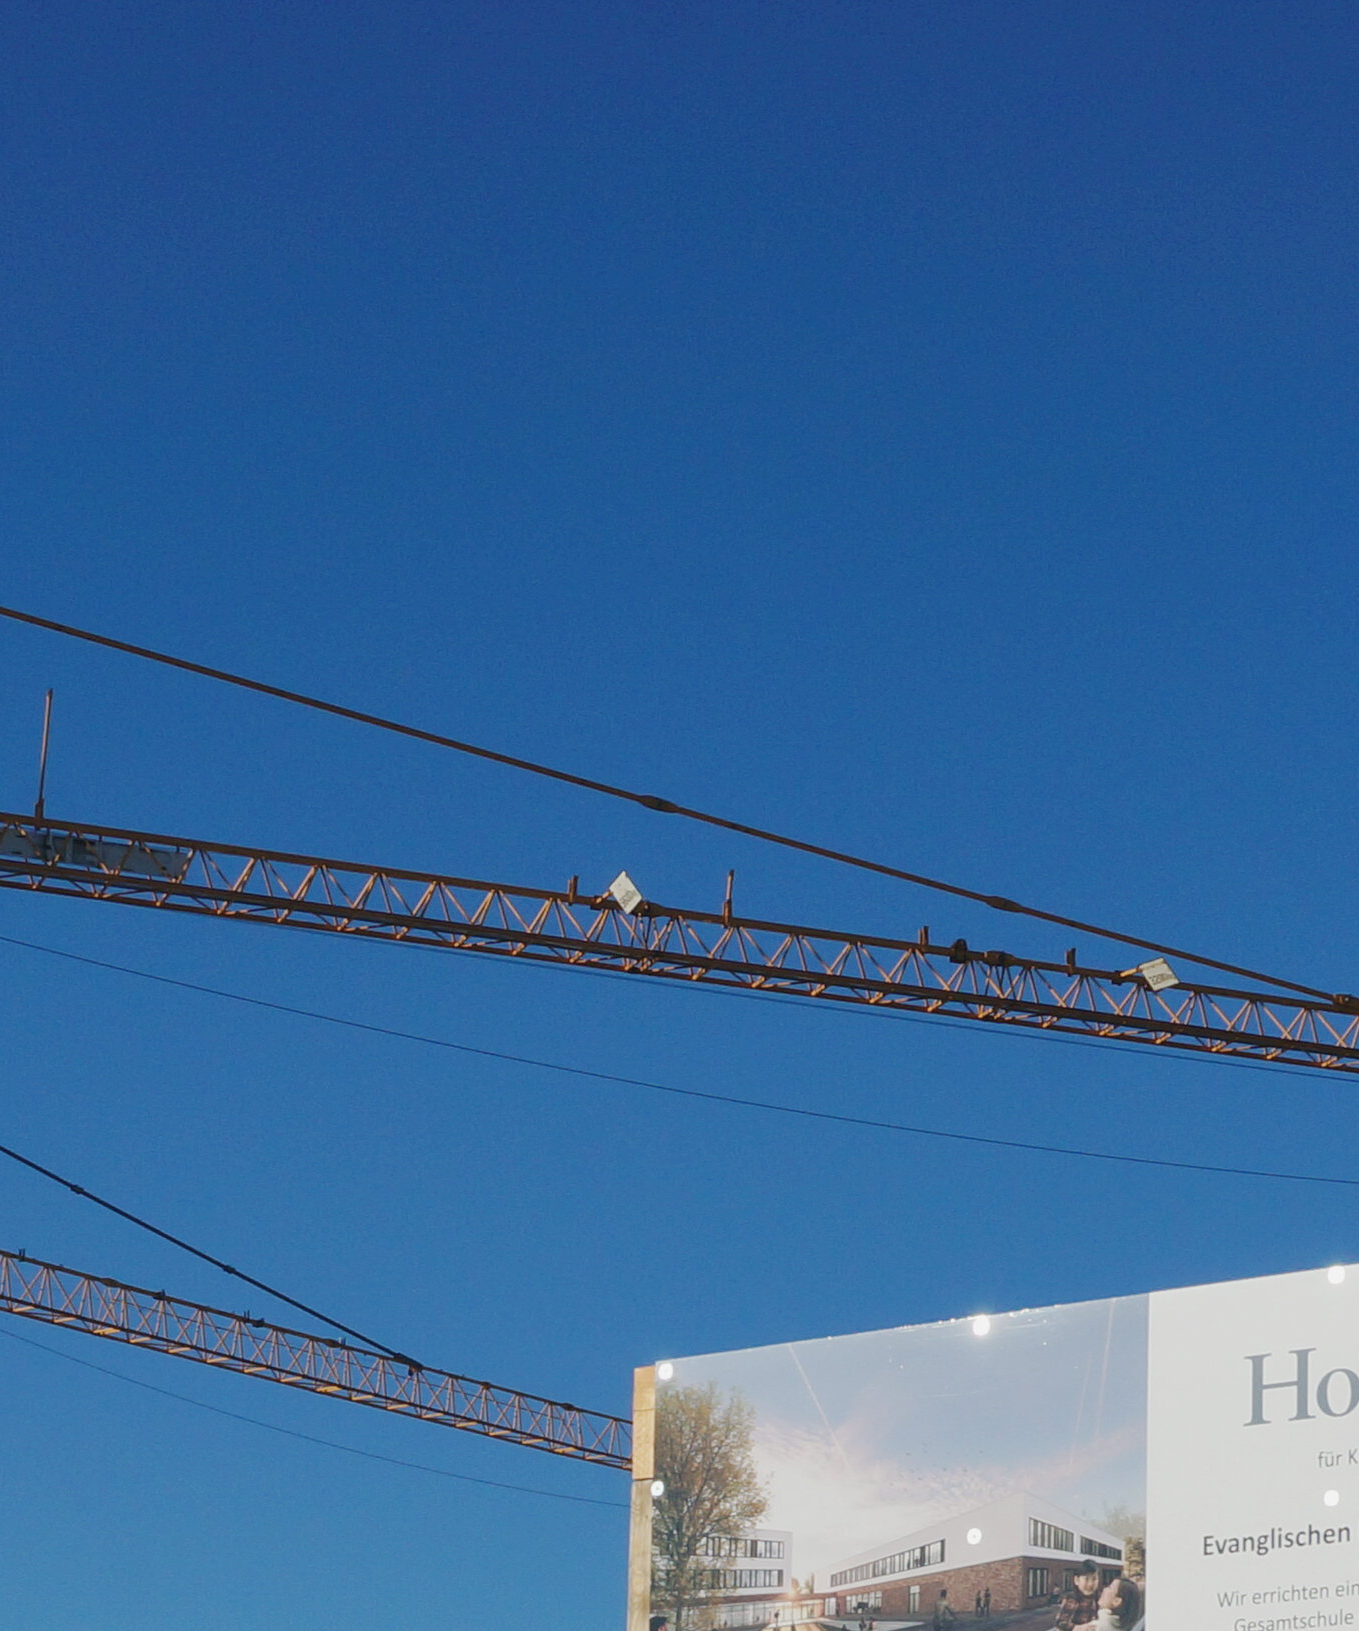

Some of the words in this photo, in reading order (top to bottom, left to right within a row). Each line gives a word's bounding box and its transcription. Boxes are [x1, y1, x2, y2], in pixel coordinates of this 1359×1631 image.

[1318, 1451, 1343, 1468] für
[1217, 1591, 1247, 1608] Wir
[1252, 1585, 1329, 1605] errichten
